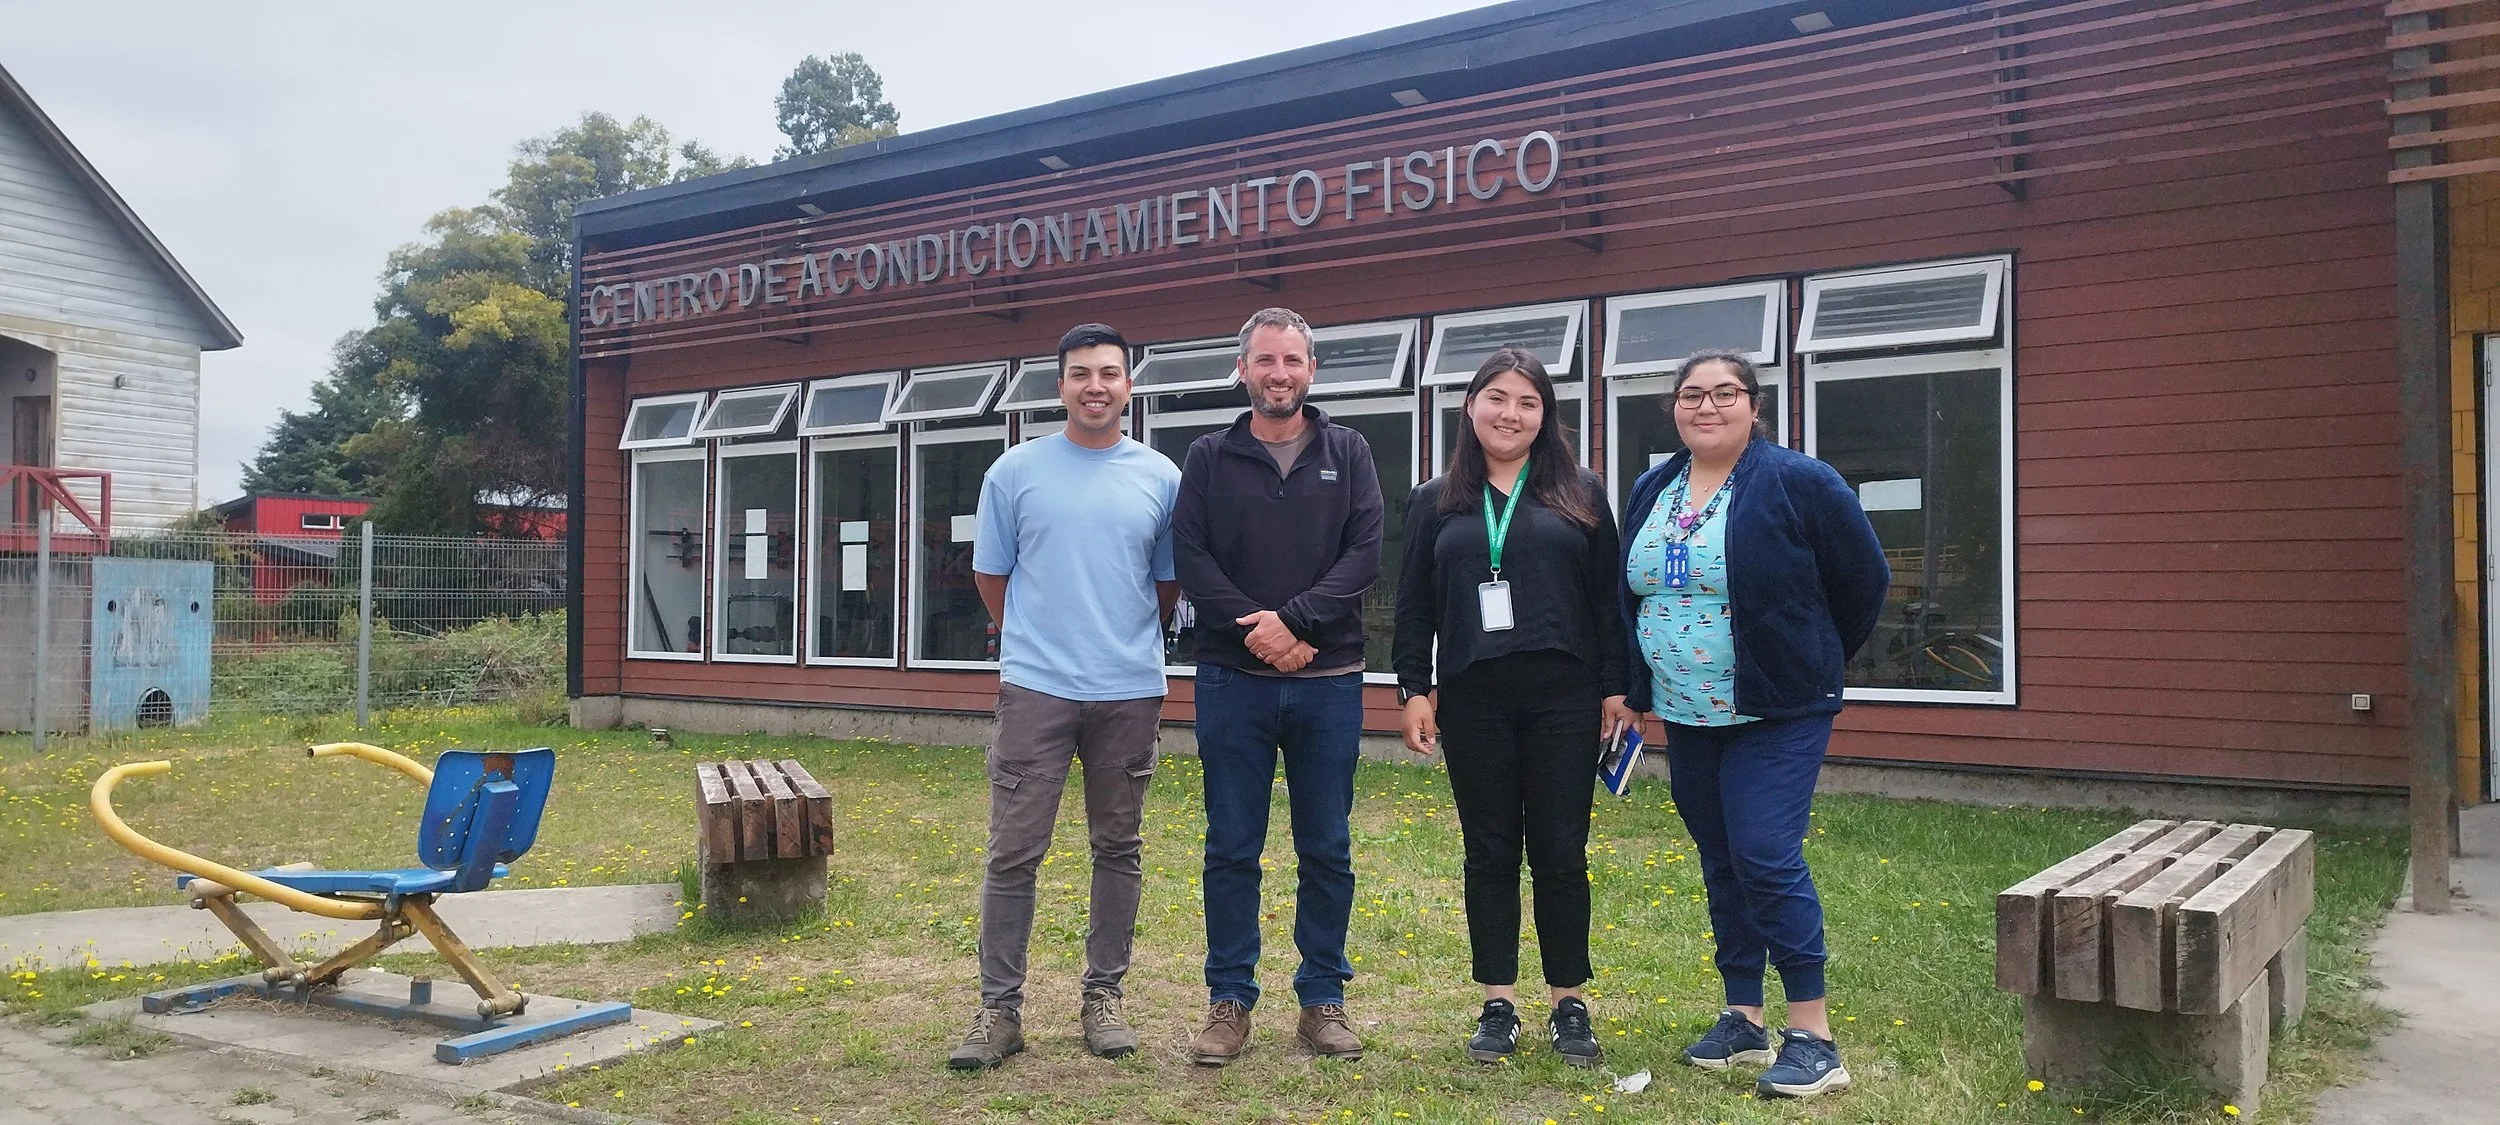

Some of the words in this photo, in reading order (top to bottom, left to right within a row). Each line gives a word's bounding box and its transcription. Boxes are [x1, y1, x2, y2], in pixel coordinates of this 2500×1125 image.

[590, 267, 731, 327] CENTRO
[738, 258, 788, 307] DE
[797, 169, 1326, 299] ACONDICIONAMIENTO
[1345, 130, 1562, 221] FISICO
